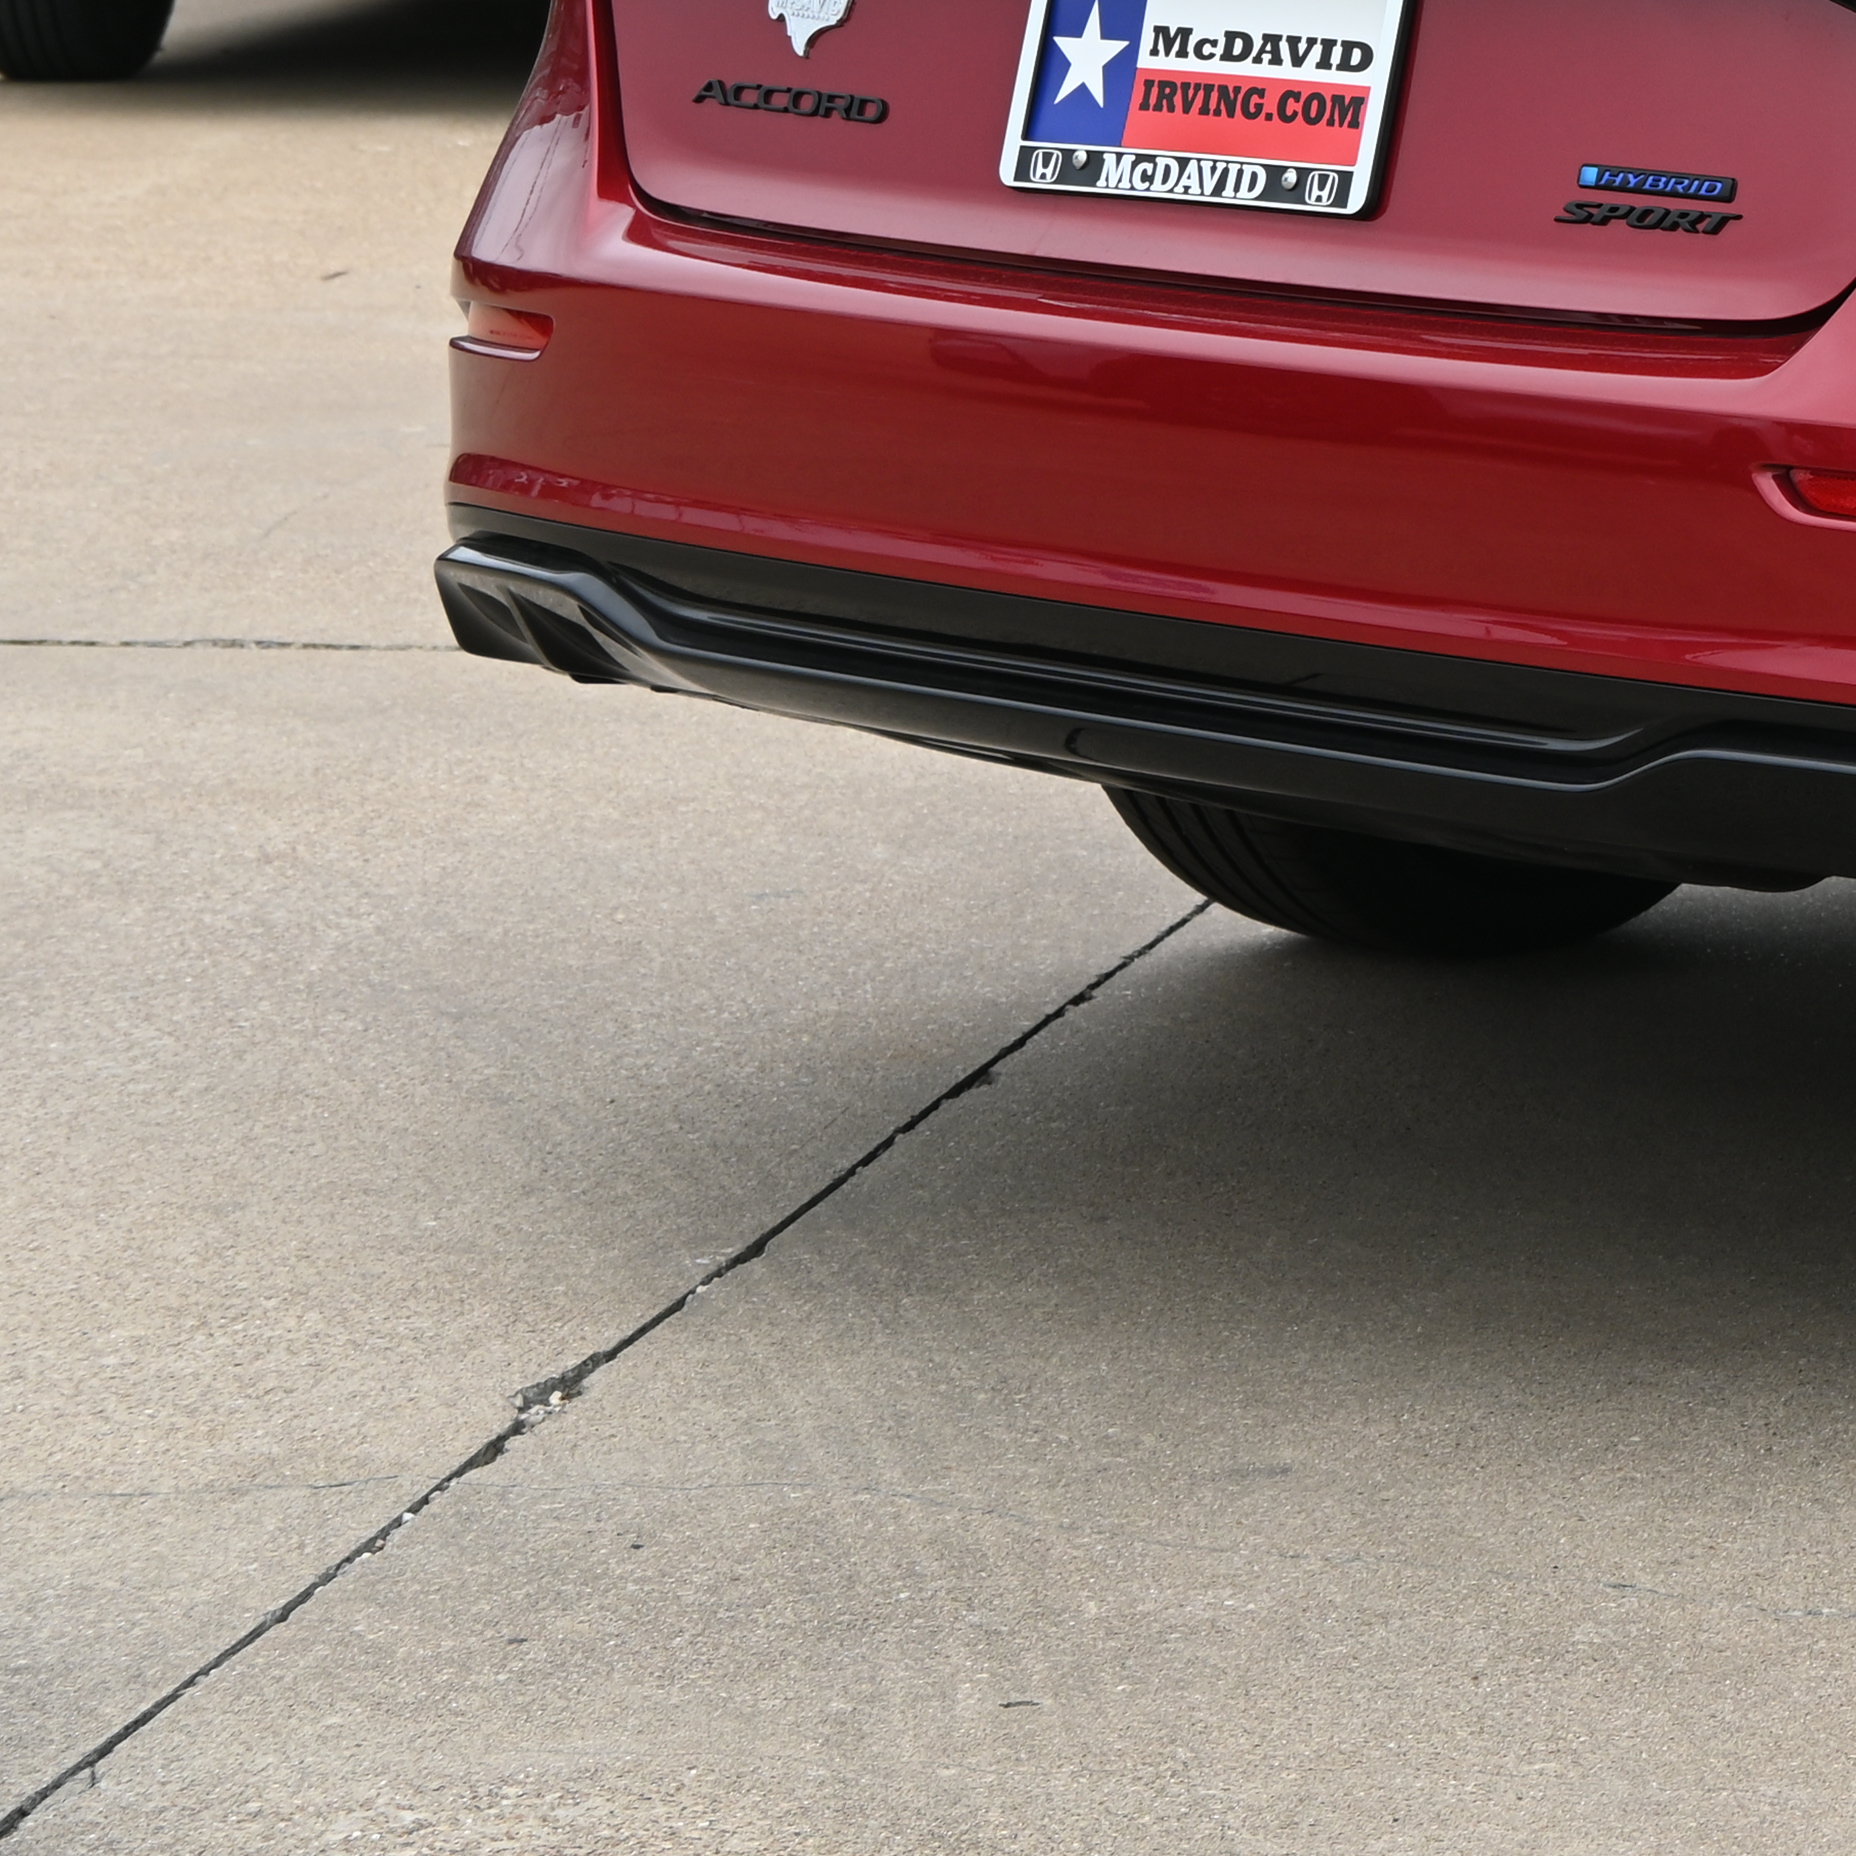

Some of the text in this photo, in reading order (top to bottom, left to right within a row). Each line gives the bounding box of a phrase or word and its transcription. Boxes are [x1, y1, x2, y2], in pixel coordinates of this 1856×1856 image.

[1149, 25, 1374, 73] McDAVID
[693, 79, 890, 124] ACCORD
[1138, 79, 1366, 130] IRVING.COM
[1095, 152, 1268, 200] McDAVID
[1599, 170, 1723, 196] HYBRID
[1554, 200, 1743, 235] SPORT
